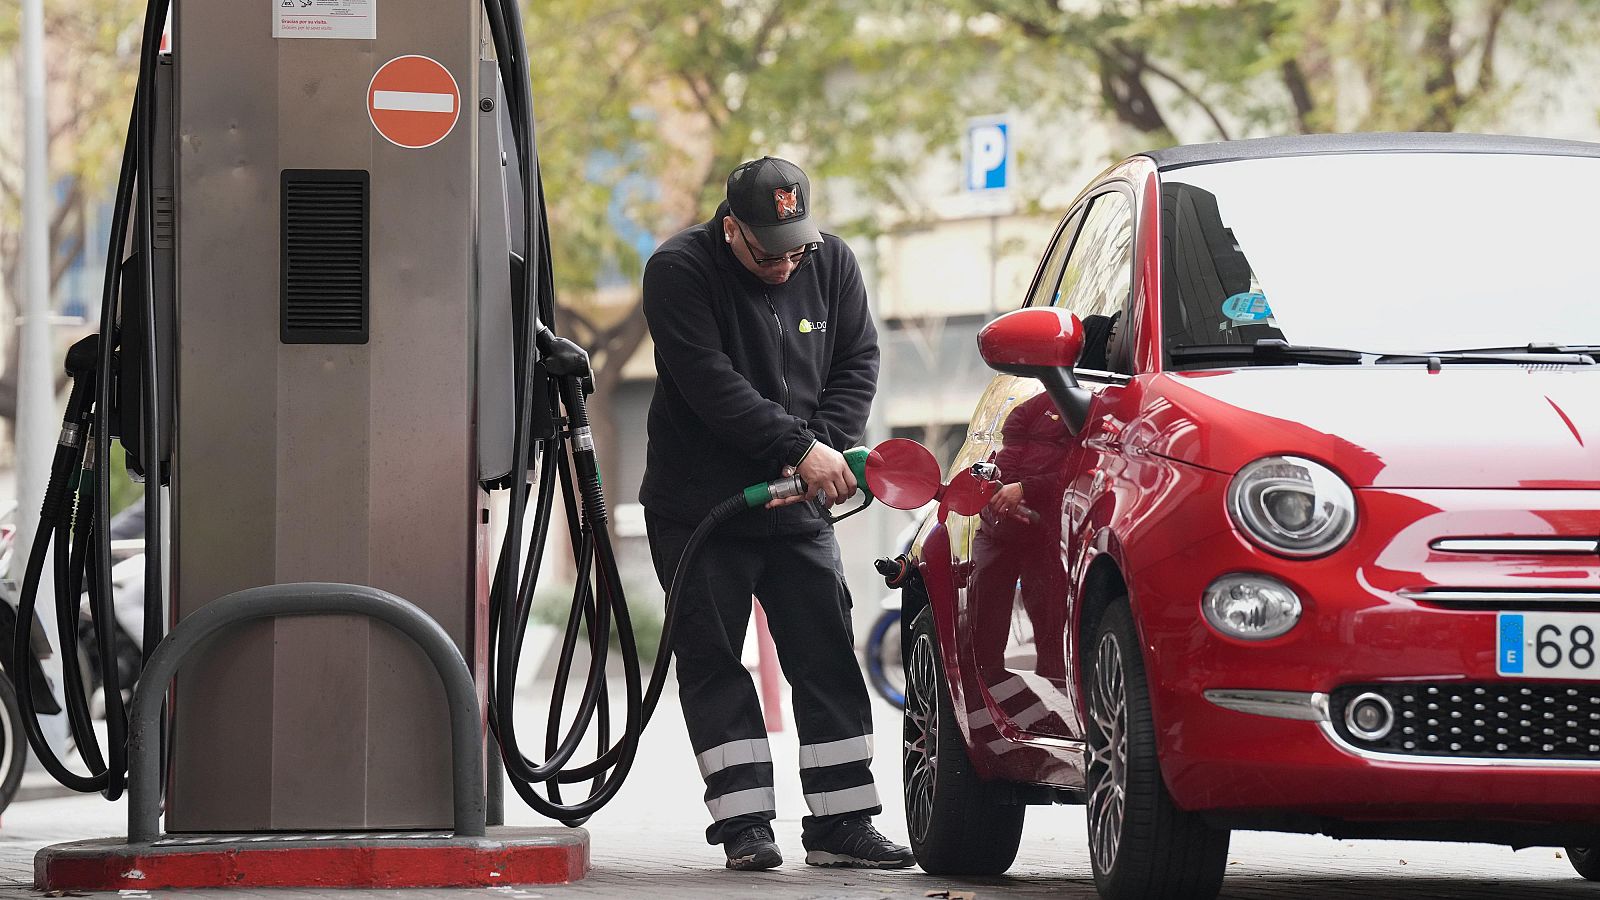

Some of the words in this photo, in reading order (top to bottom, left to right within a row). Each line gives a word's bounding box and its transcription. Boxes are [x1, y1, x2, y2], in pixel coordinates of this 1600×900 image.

[972, 126, 1005, 188] P
[1507, 650, 1516, 663] E
[1536, 624, 1595, 669] 68
